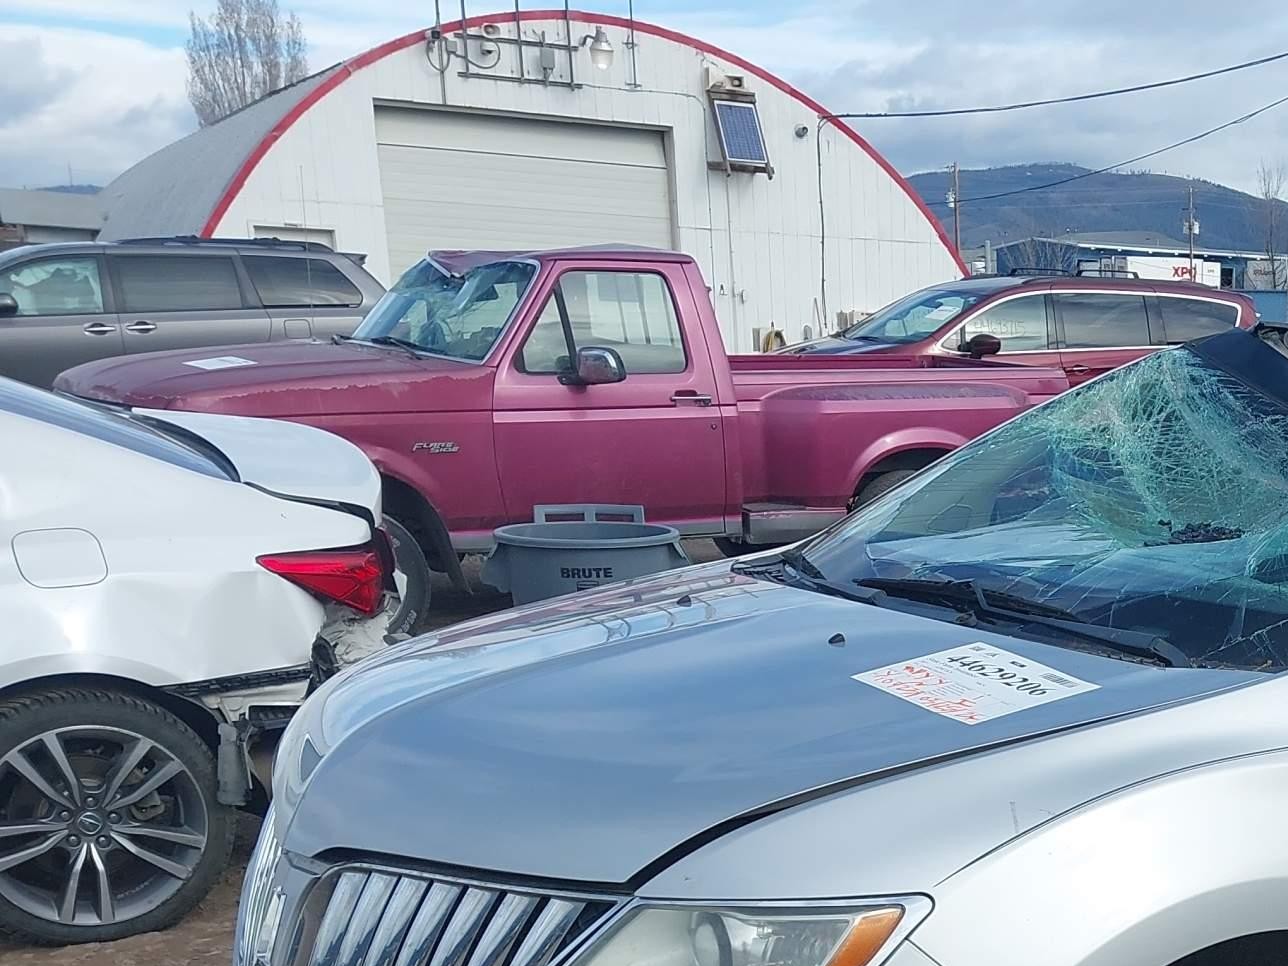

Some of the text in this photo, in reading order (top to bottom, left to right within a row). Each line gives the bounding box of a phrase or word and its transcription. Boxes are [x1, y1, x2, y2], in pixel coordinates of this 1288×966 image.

[1172, 266, 1197, 277] XPO
[560, 567, 614, 579] BRUTE
[947, 655, 1055, 697] 44629206
